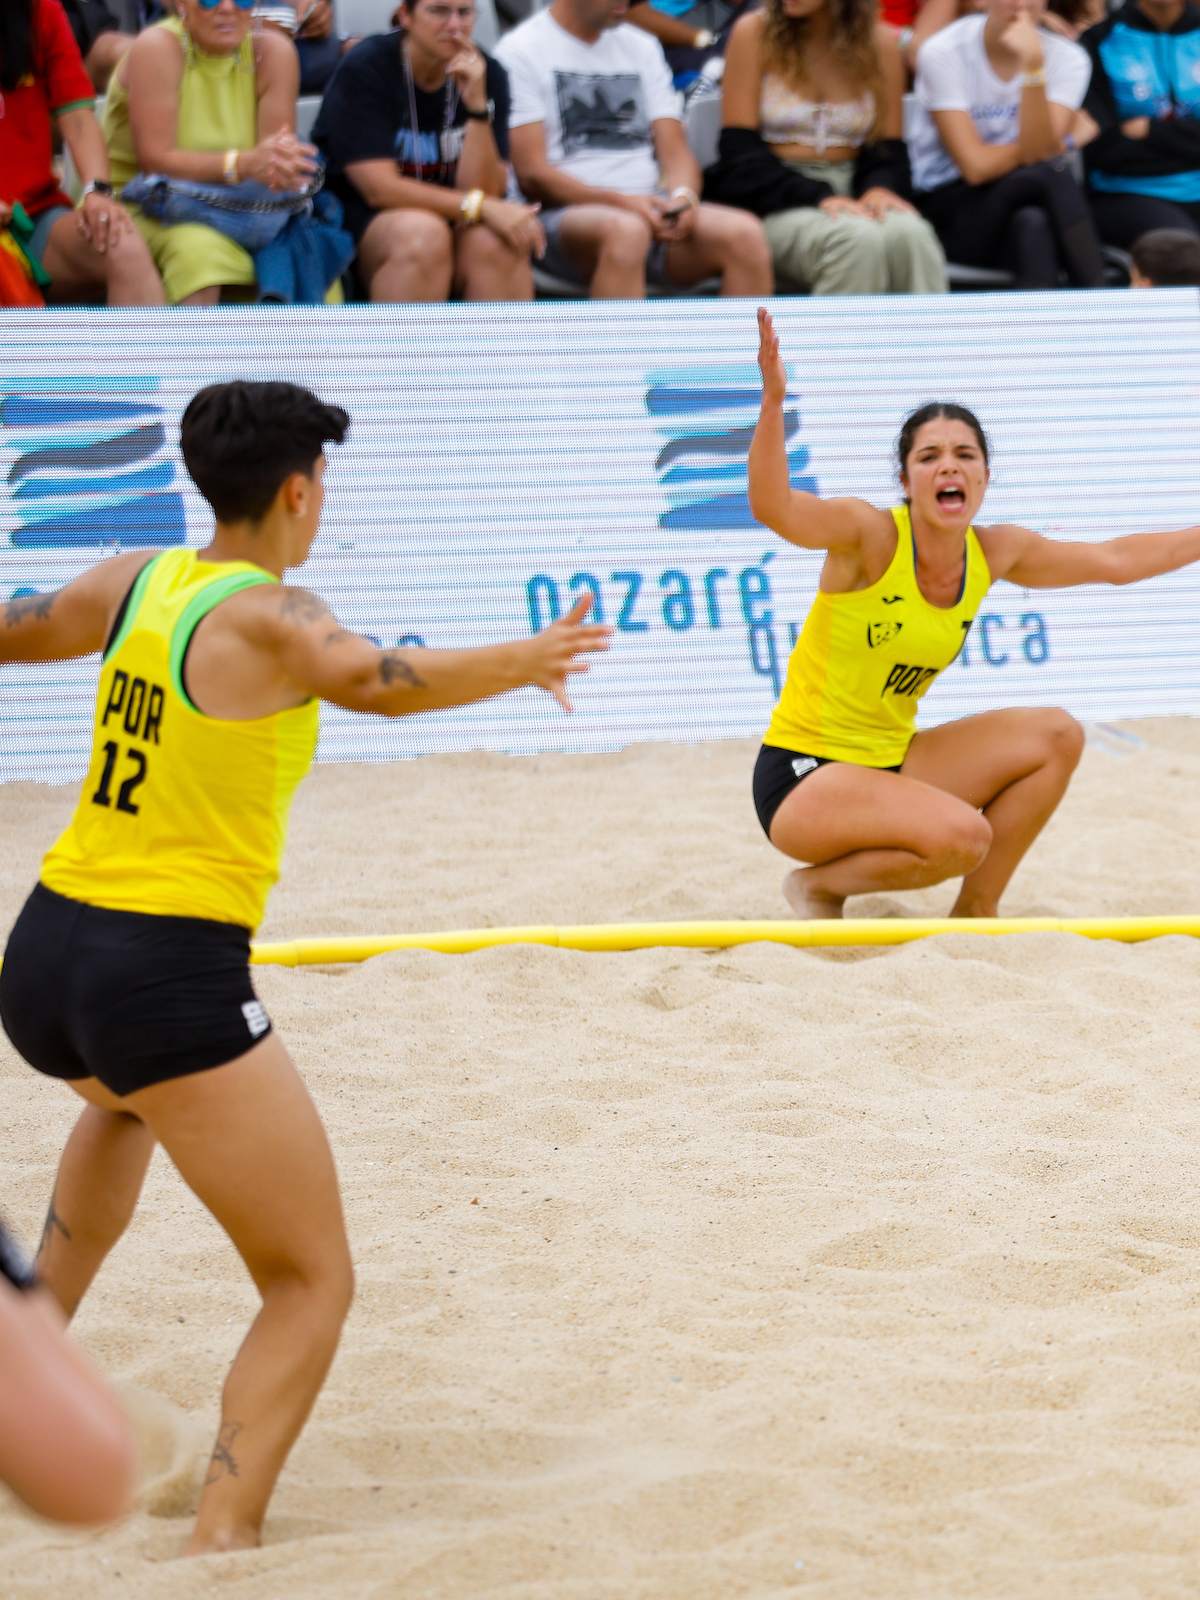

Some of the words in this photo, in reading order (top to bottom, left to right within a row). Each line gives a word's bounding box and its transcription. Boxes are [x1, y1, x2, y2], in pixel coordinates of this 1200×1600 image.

[527, 552, 776, 635] nazaré
[102, 668, 165, 746] POR
[881, 664, 939, 697] POR
[92, 740, 147, 816] 12
